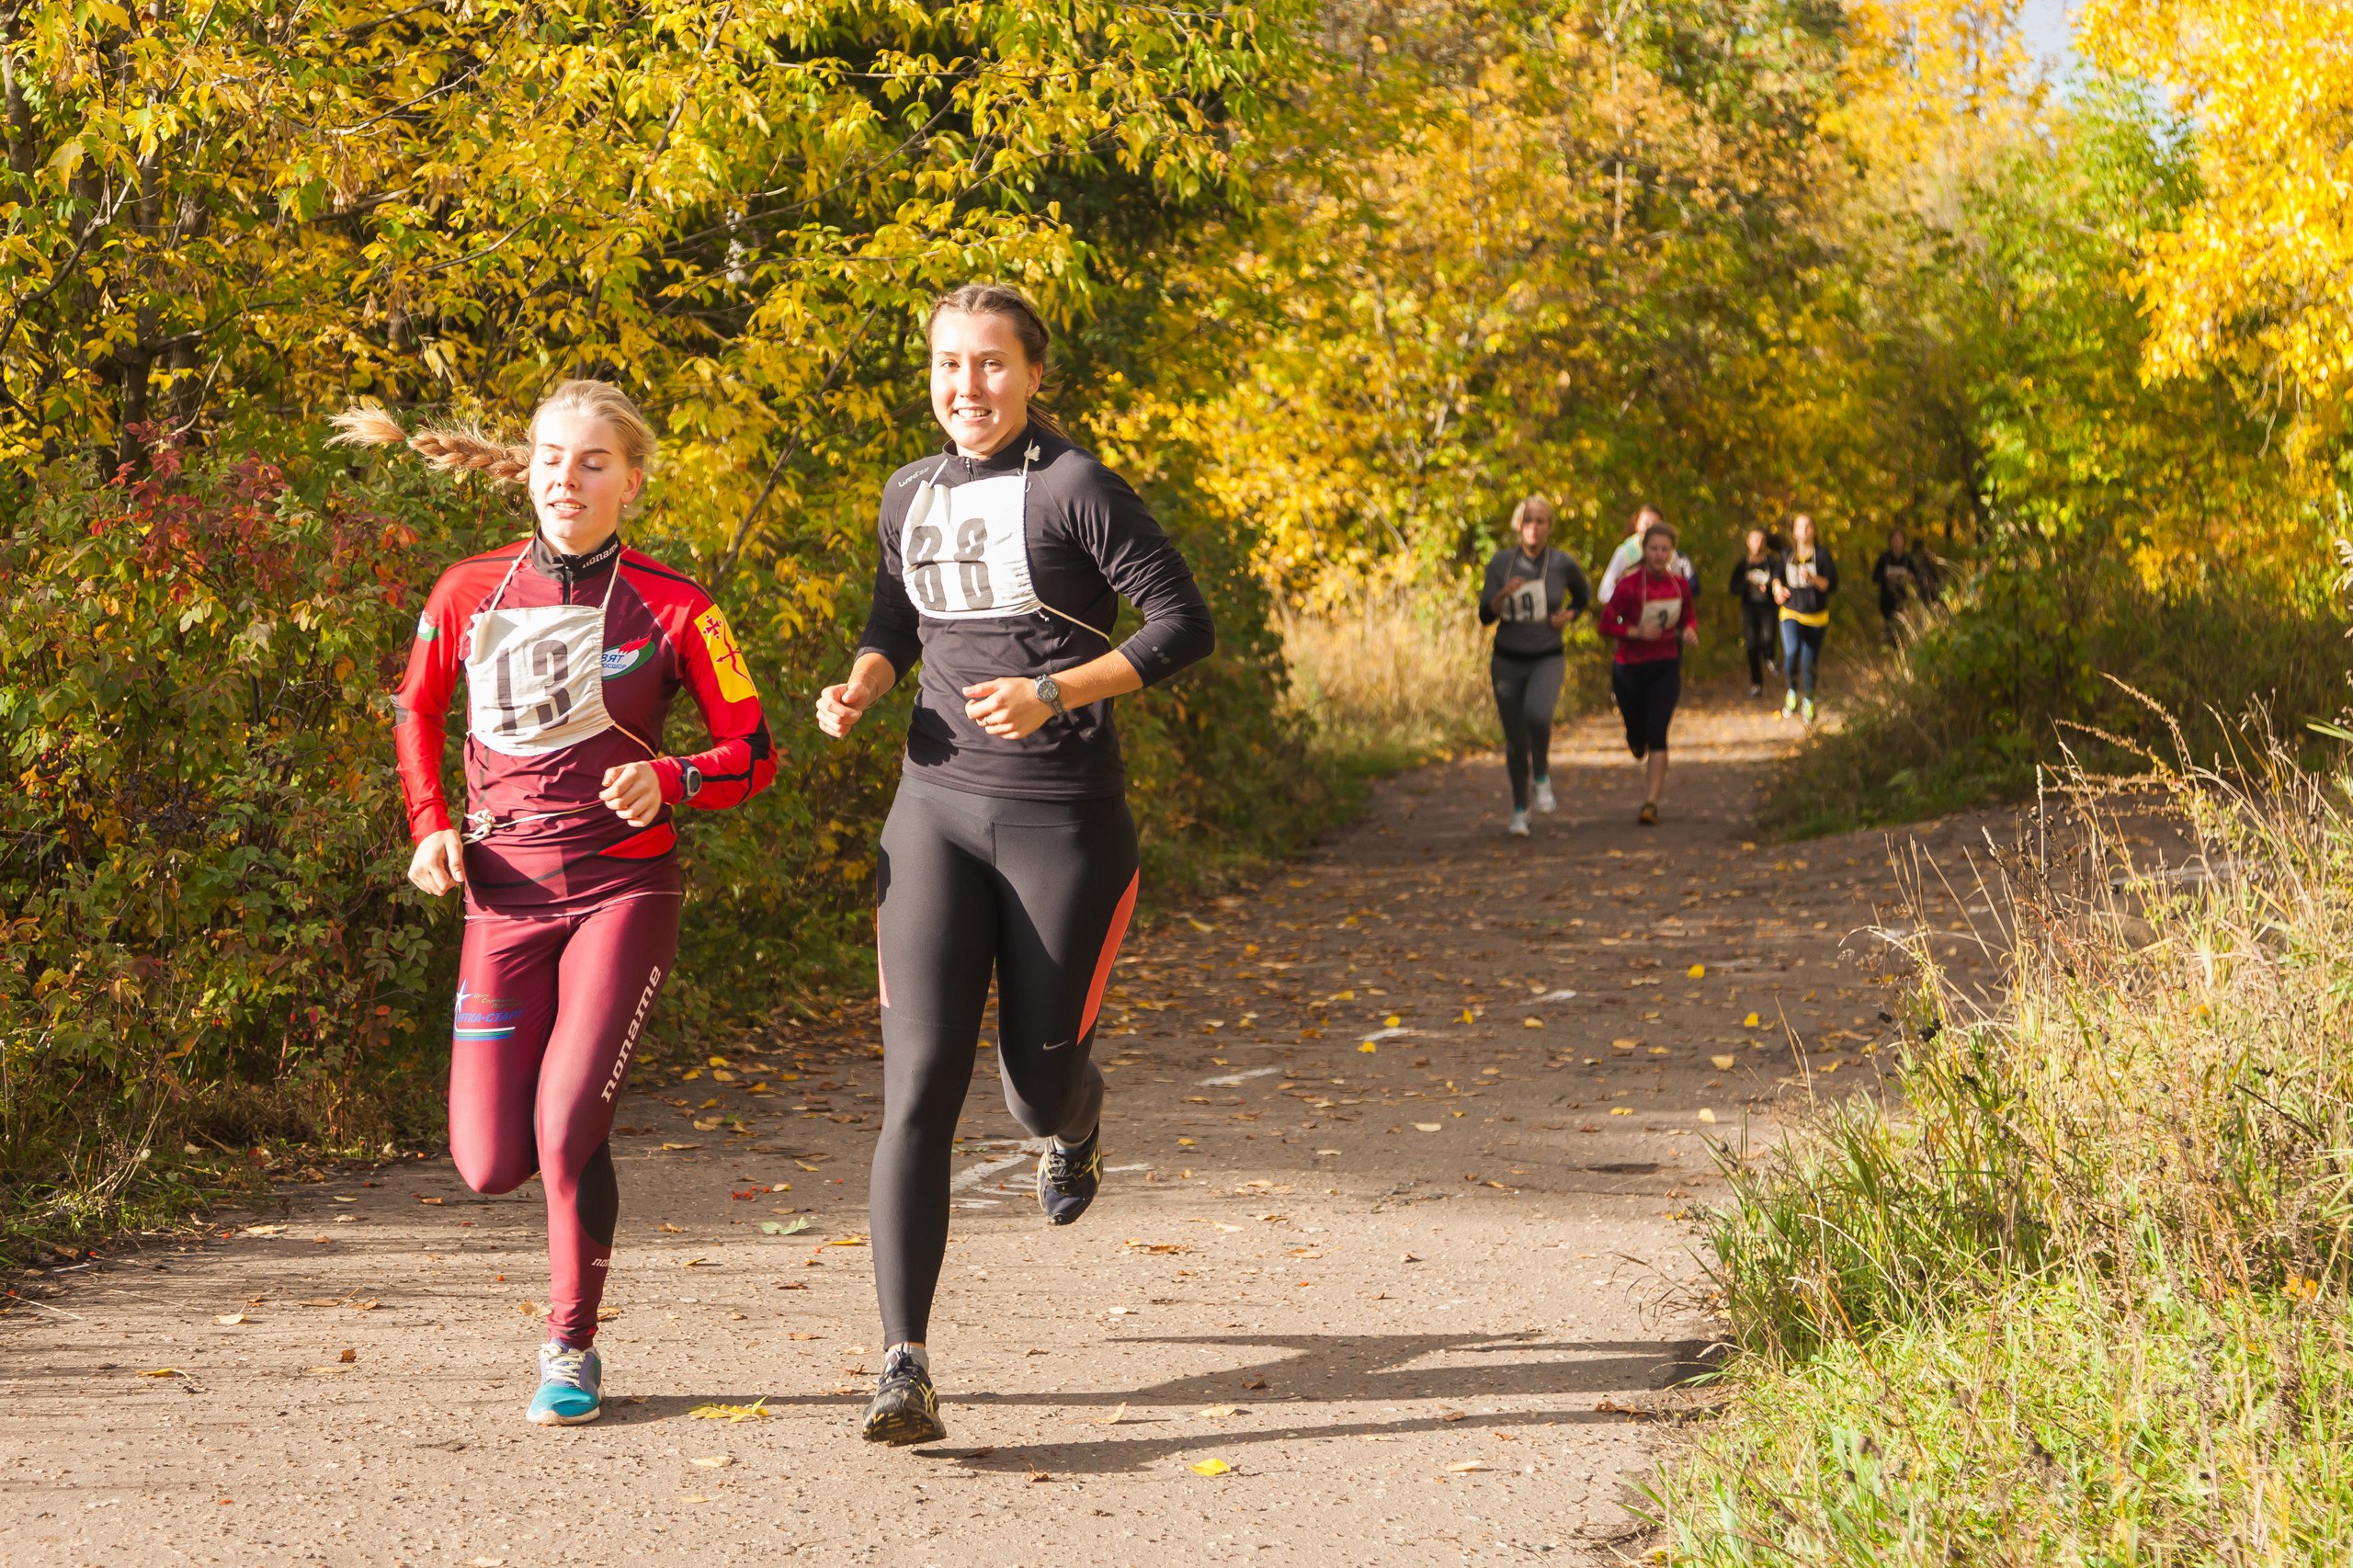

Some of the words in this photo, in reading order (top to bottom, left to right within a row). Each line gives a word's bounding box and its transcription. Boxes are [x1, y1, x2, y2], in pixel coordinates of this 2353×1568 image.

[906, 517, 995, 612] 88
[496, 639, 572, 737] 13
[600, 965, 662, 1103] noname
